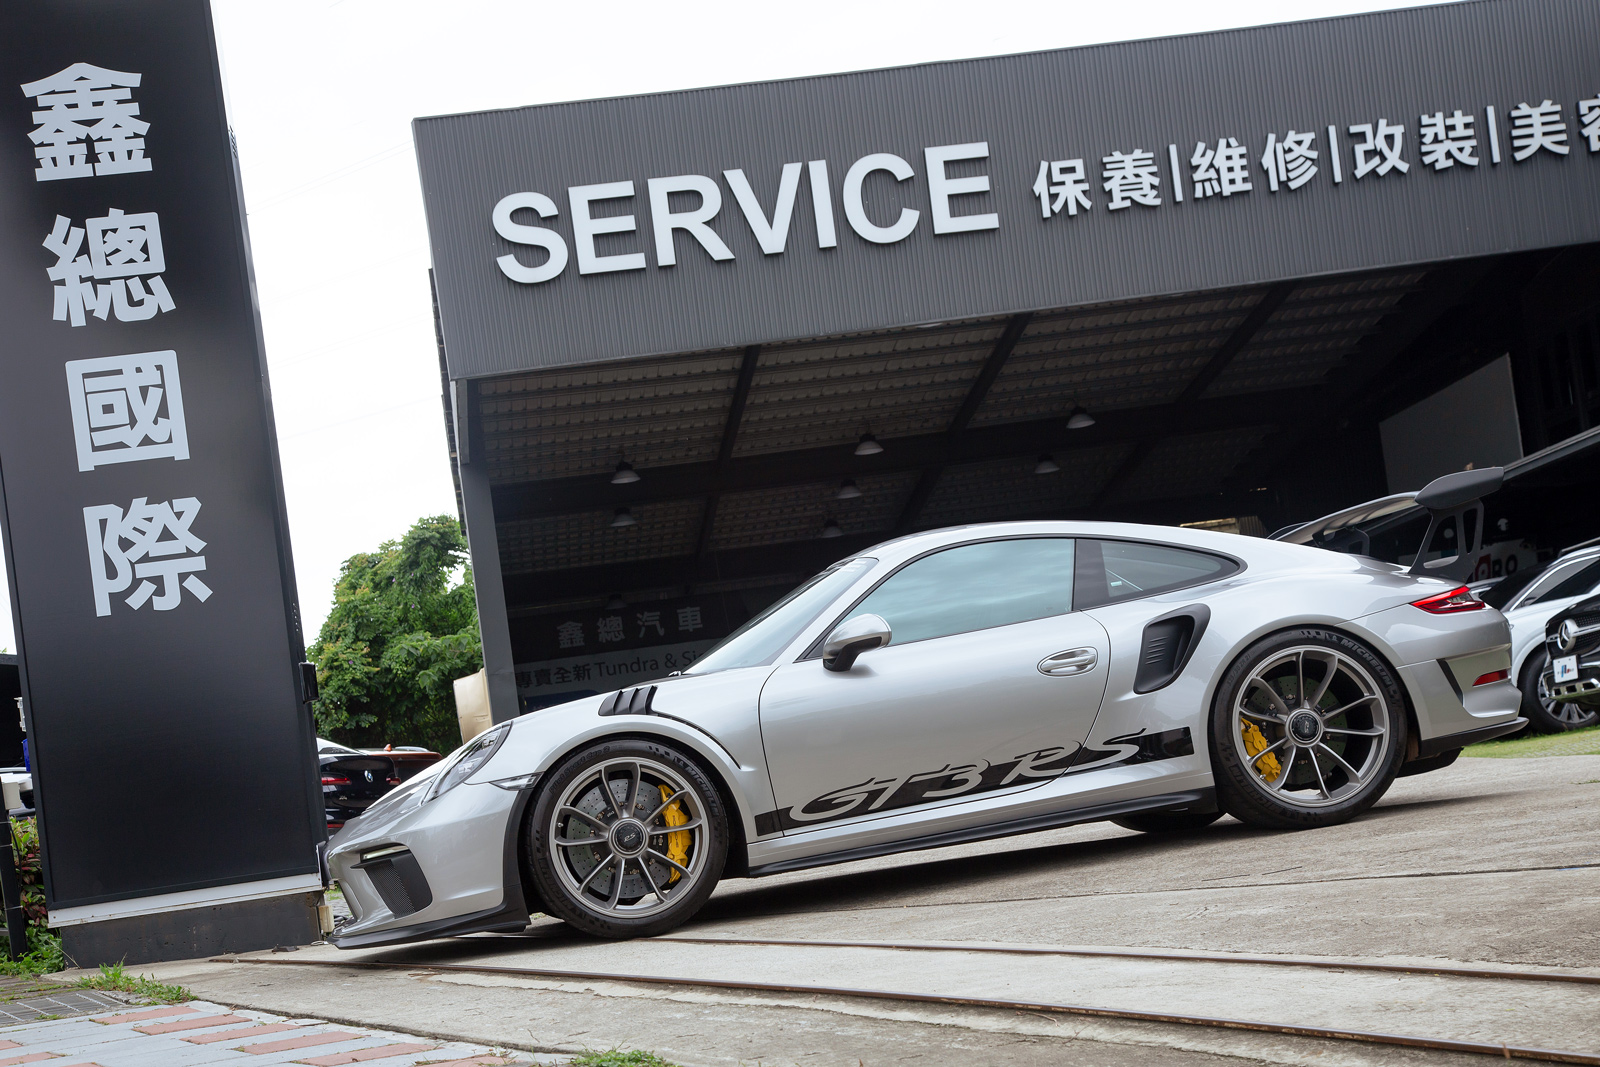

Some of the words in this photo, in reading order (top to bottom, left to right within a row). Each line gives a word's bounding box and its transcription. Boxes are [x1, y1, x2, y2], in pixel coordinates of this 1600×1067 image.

[491, 141, 1000, 284] SERVICE
[20, 62, 214, 618] 鑫總國際
[556, 606, 704, 649] 鑫總汽車
[594, 657, 659, 677] Tundra
[665, 653, 677, 668] &
[1340, 639, 1393, 688] MICHELIN
[564, 756, 586, 777] Sport
[684, 765, 720, 817] MICHELIN
[789, 759, 990, 822] GT3
[999, 728, 1147, 785] RS
